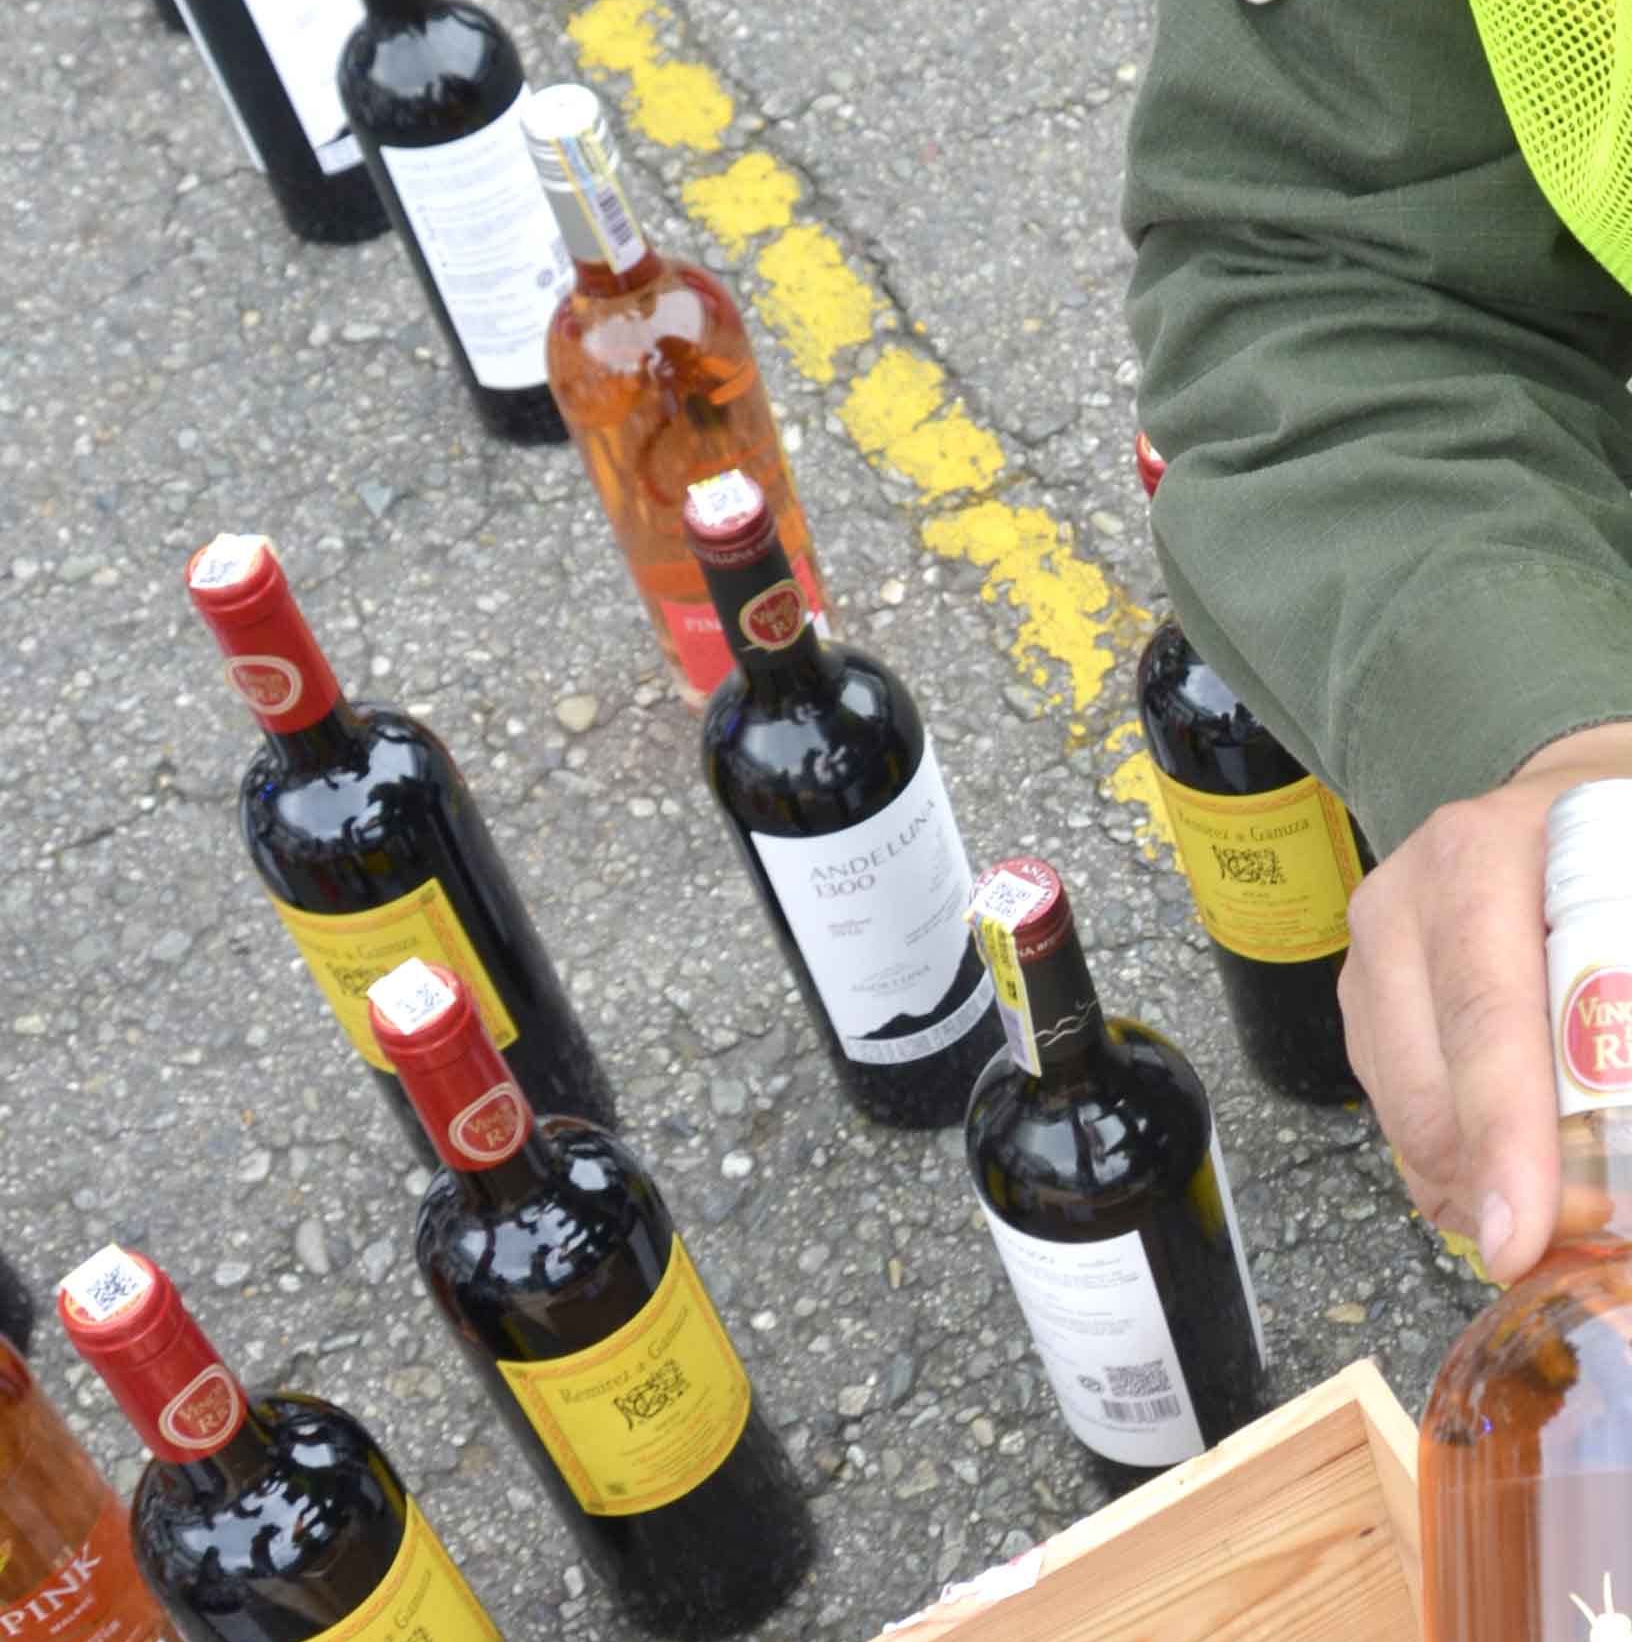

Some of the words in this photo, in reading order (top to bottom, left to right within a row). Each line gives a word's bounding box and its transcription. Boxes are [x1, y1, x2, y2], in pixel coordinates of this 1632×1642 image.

[808, 798, 936, 883] ANDELUNA
[813, 874, 877, 900] 1300
[0, 1540, 103, 1638] PINK
